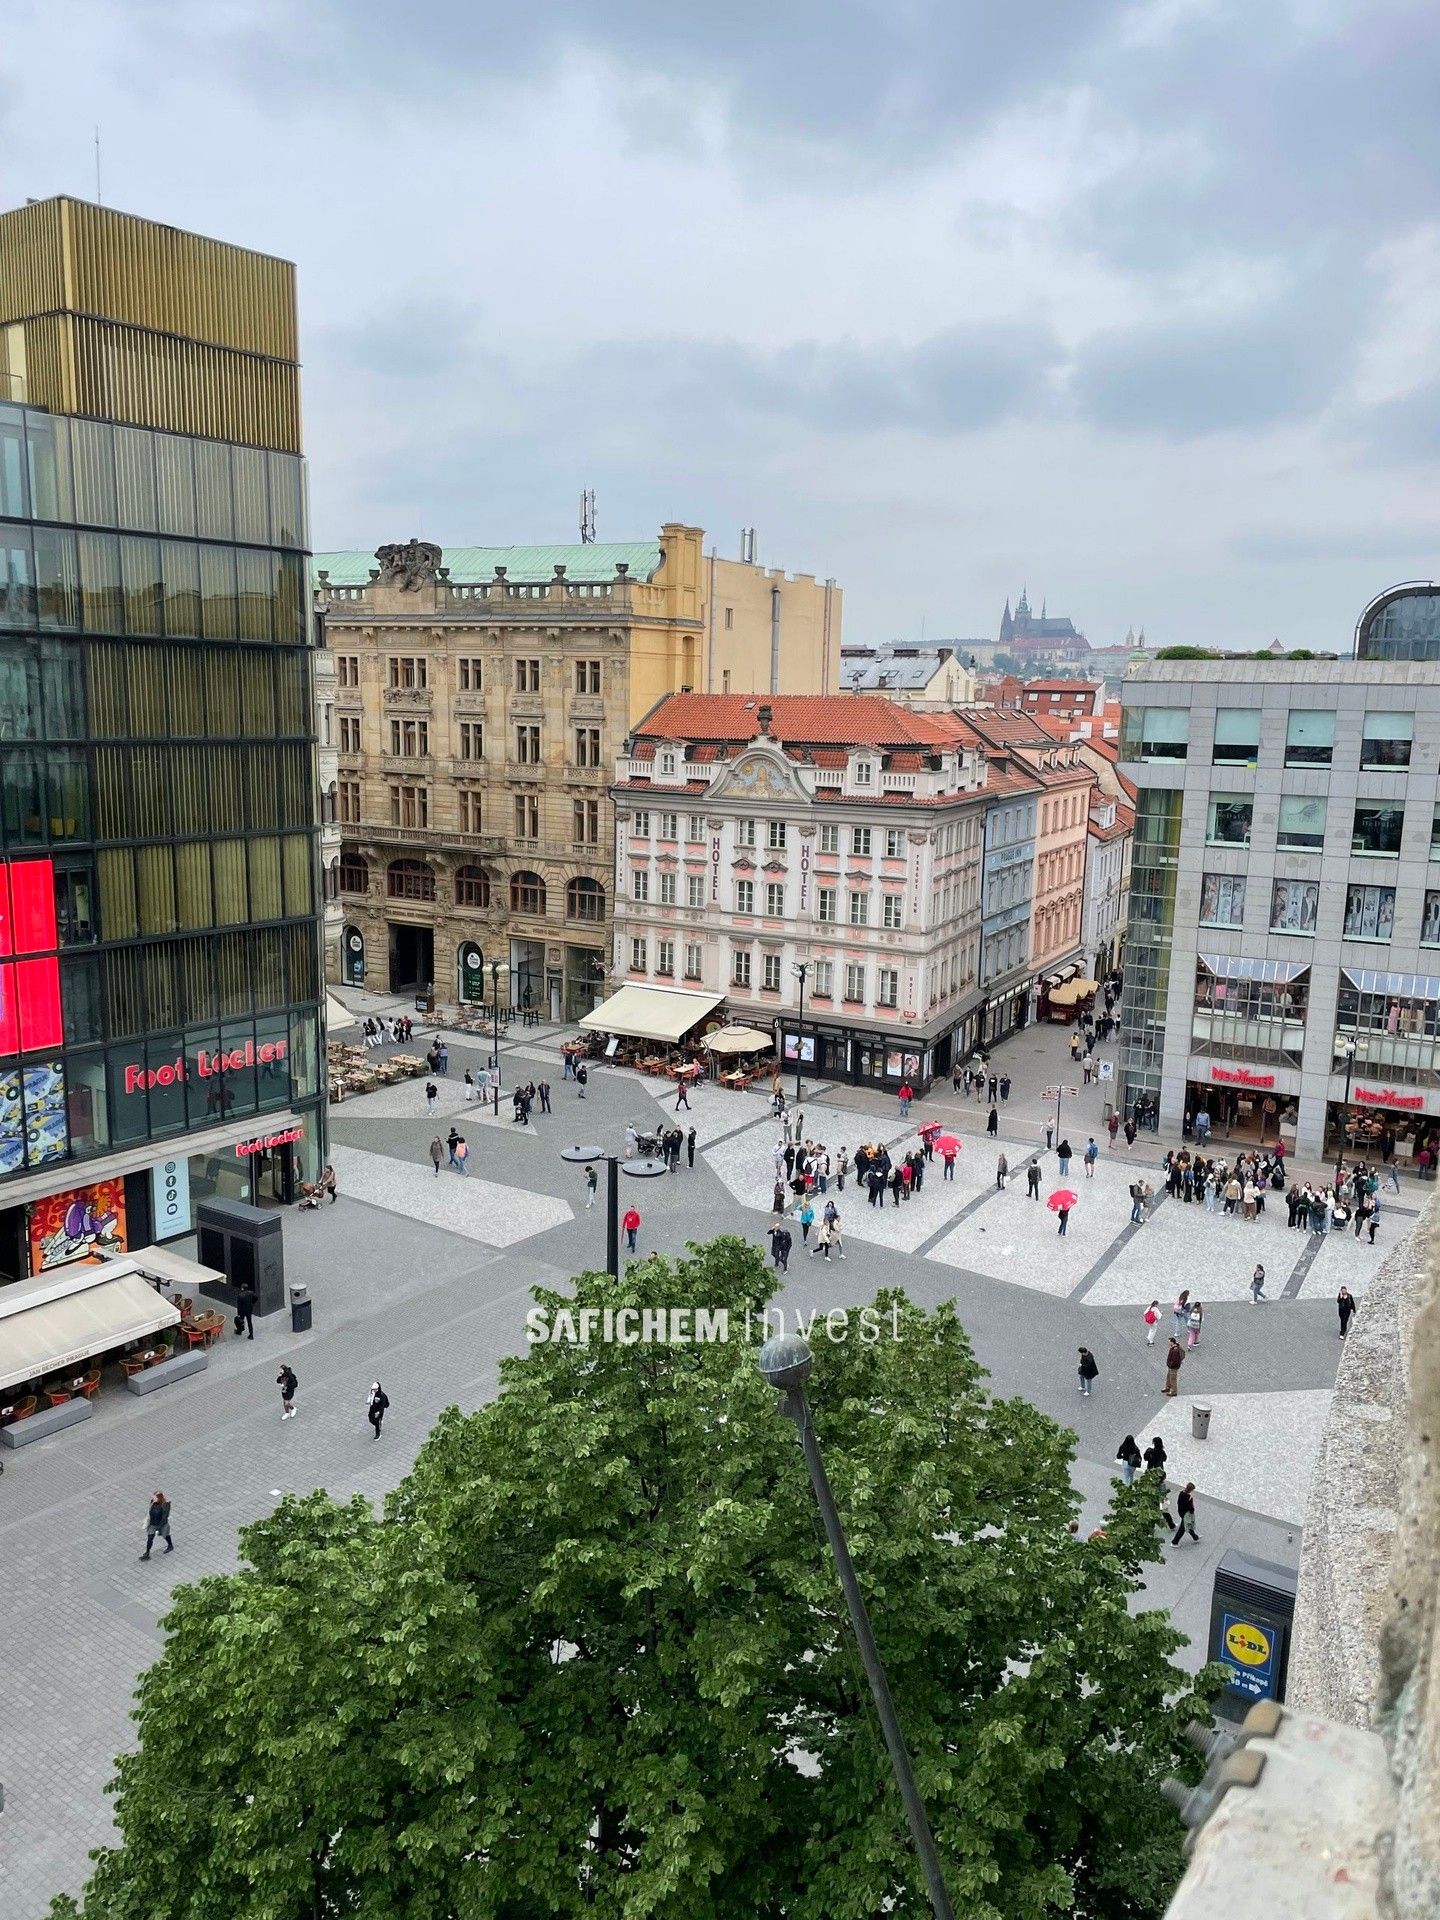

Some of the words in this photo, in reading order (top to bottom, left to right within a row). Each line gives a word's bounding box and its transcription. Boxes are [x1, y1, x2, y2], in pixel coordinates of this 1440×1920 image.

[712, 838, 720, 901] HOTEL
[801, 845, 809, 910] HOTEL
[124, 1056, 188, 1094] Foot
[198, 1040, 287, 1078] Locker
[235, 1139, 263, 1158] Foot
[264, 1129, 304, 1148] Locker
[29, 1369, 41, 1377] JAN
[41, 1359, 65, 1371] BECHER
[66, 1350, 90, 1363] PRAGUE
[1229, 1634, 1267, 1655] LIDL
